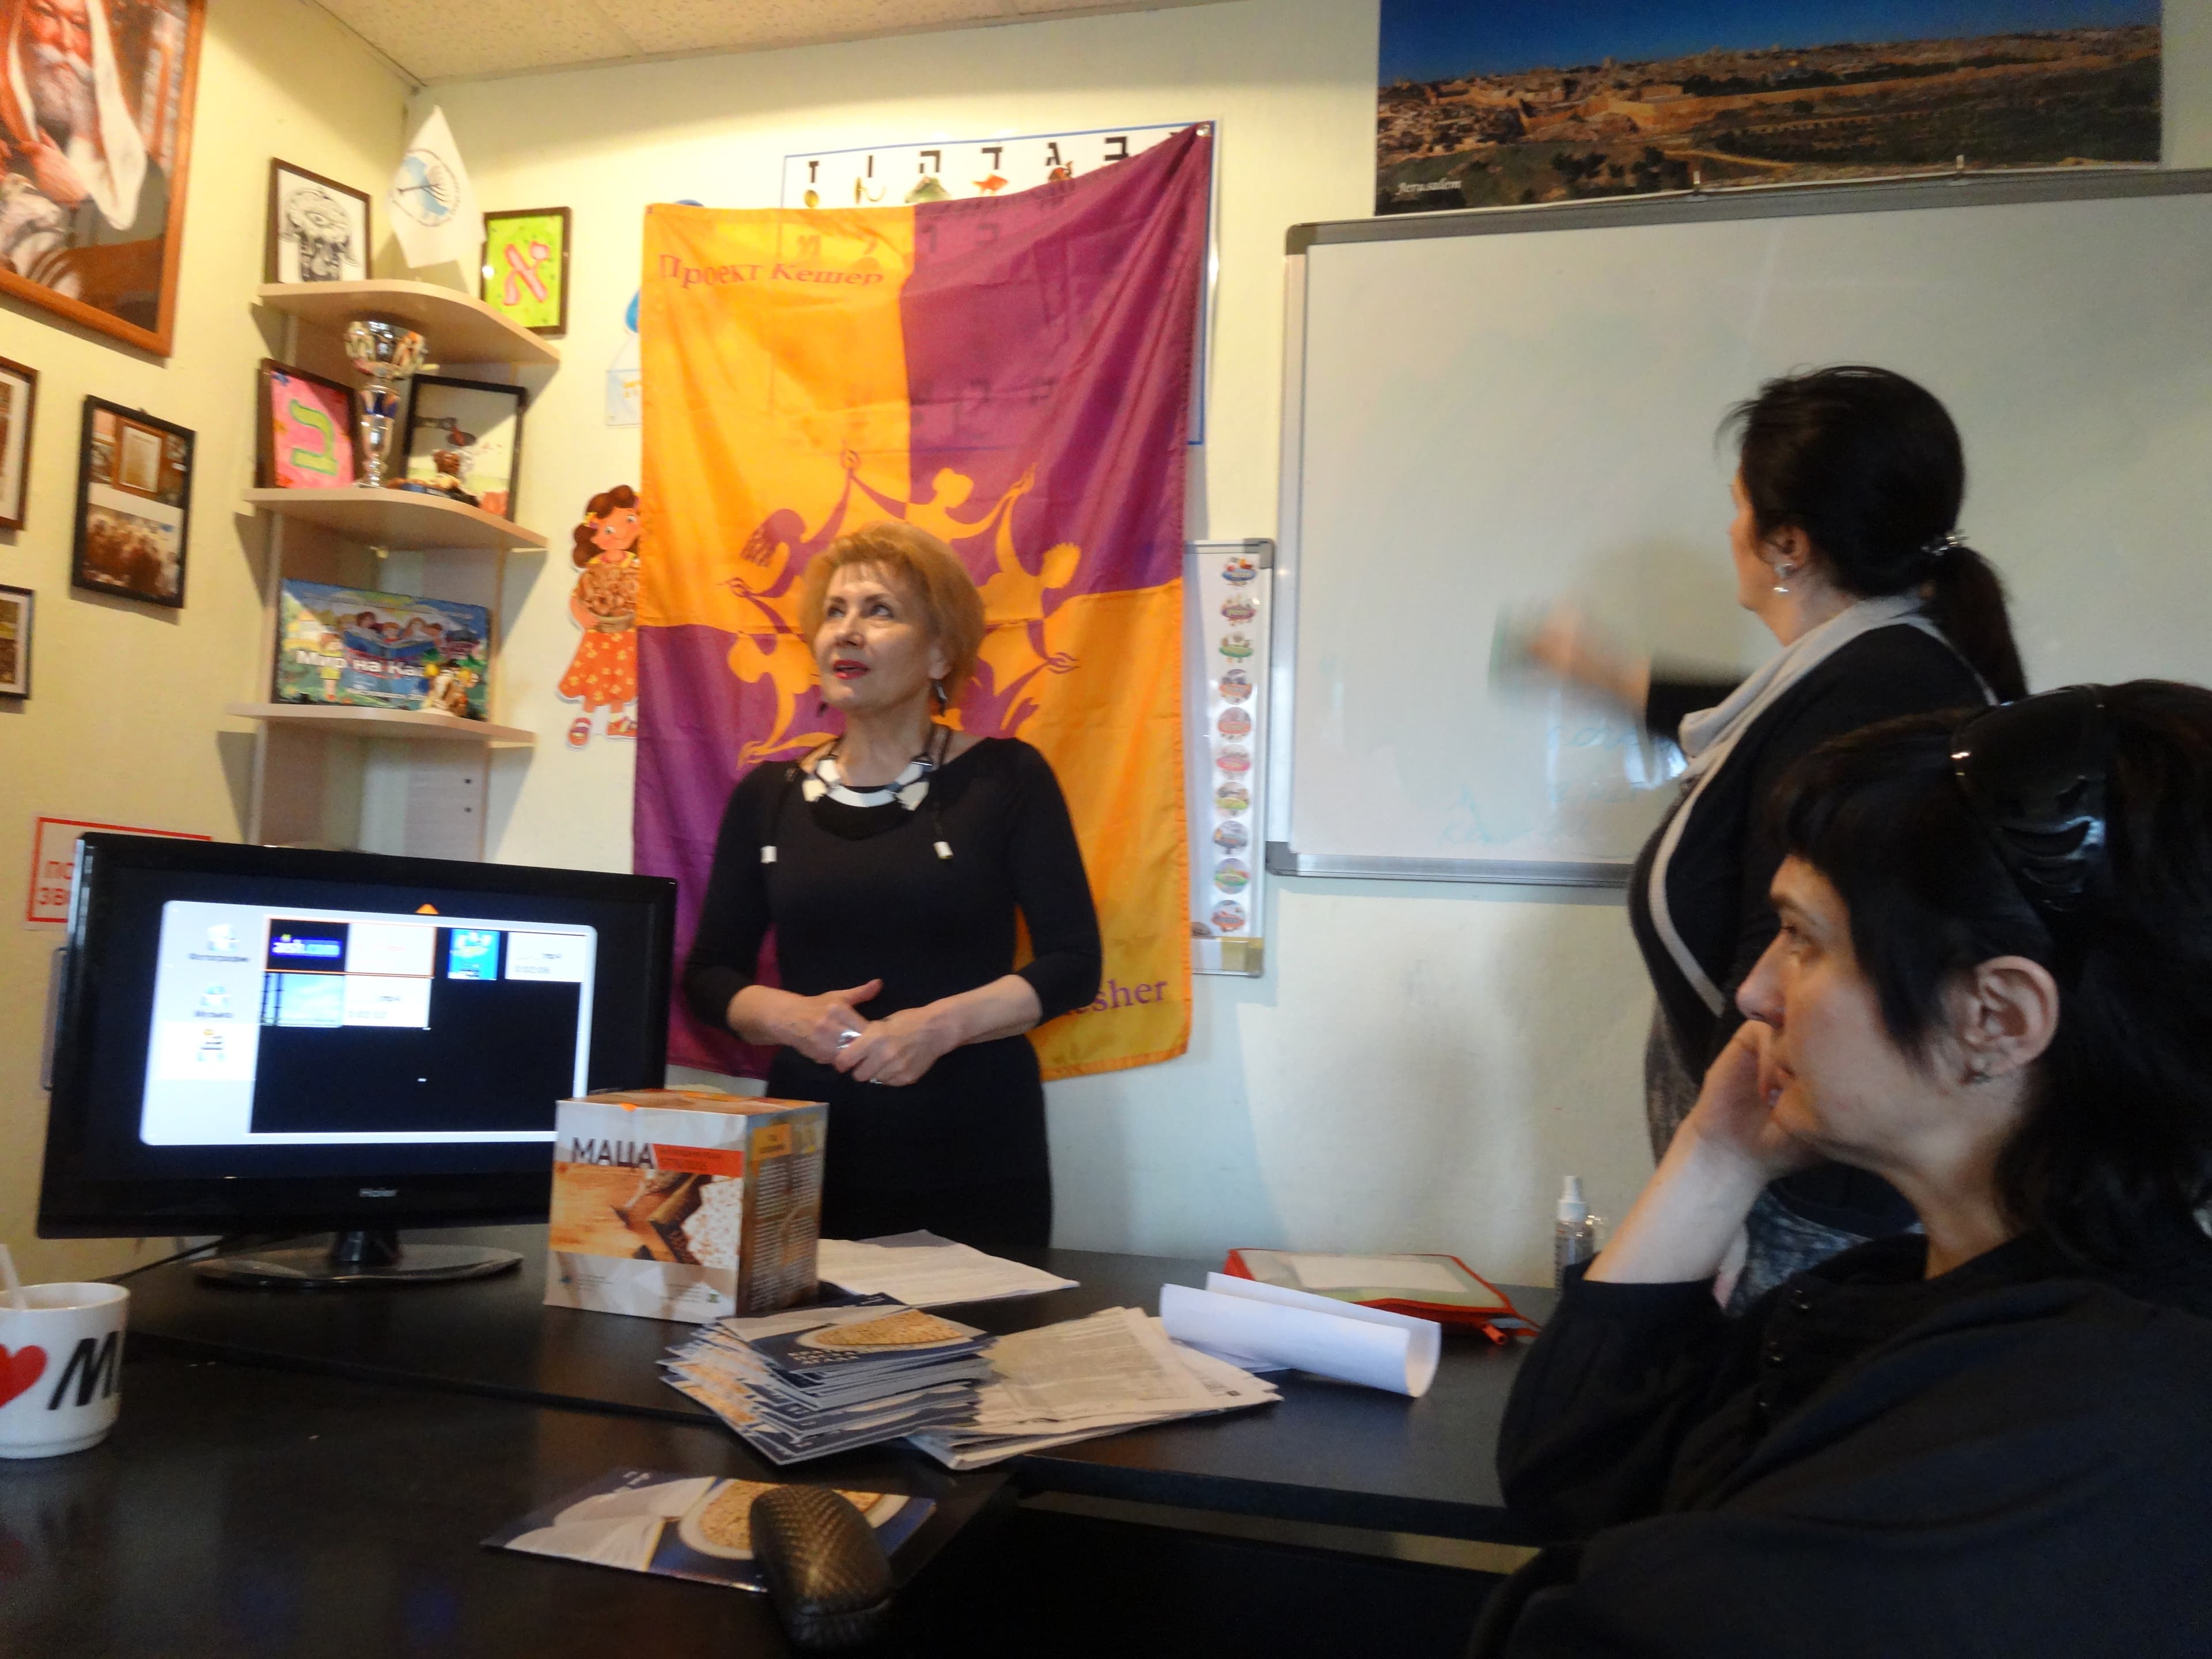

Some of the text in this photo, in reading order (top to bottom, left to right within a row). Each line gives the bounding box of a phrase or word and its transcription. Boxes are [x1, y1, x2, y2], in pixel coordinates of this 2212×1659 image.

[919, 150, 941, 173] ה
[659, 253, 884, 289] Проект Кешер
[1067, 979, 1168, 1014] sher
[571, 1137, 655, 1172] МАЦА
